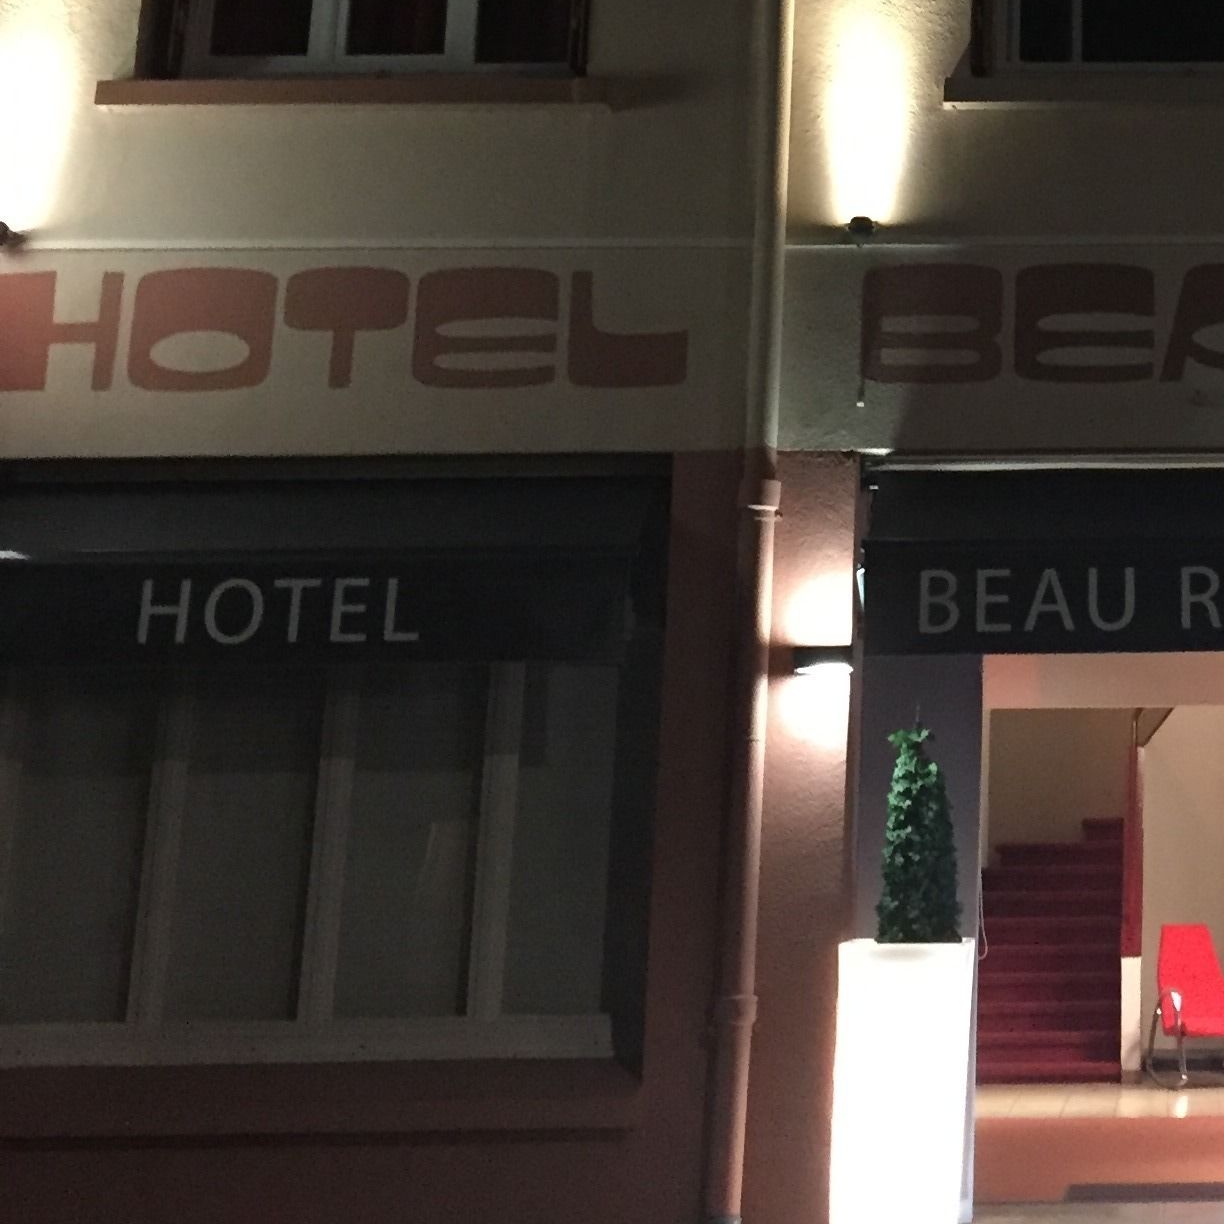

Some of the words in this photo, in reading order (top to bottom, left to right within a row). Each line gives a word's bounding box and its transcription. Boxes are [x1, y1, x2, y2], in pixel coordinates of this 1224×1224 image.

[0, 267, 688, 391] HOTEL
[136, 578, 420, 644] HOTEL
[917, 567, 1137, 635] BEAU
